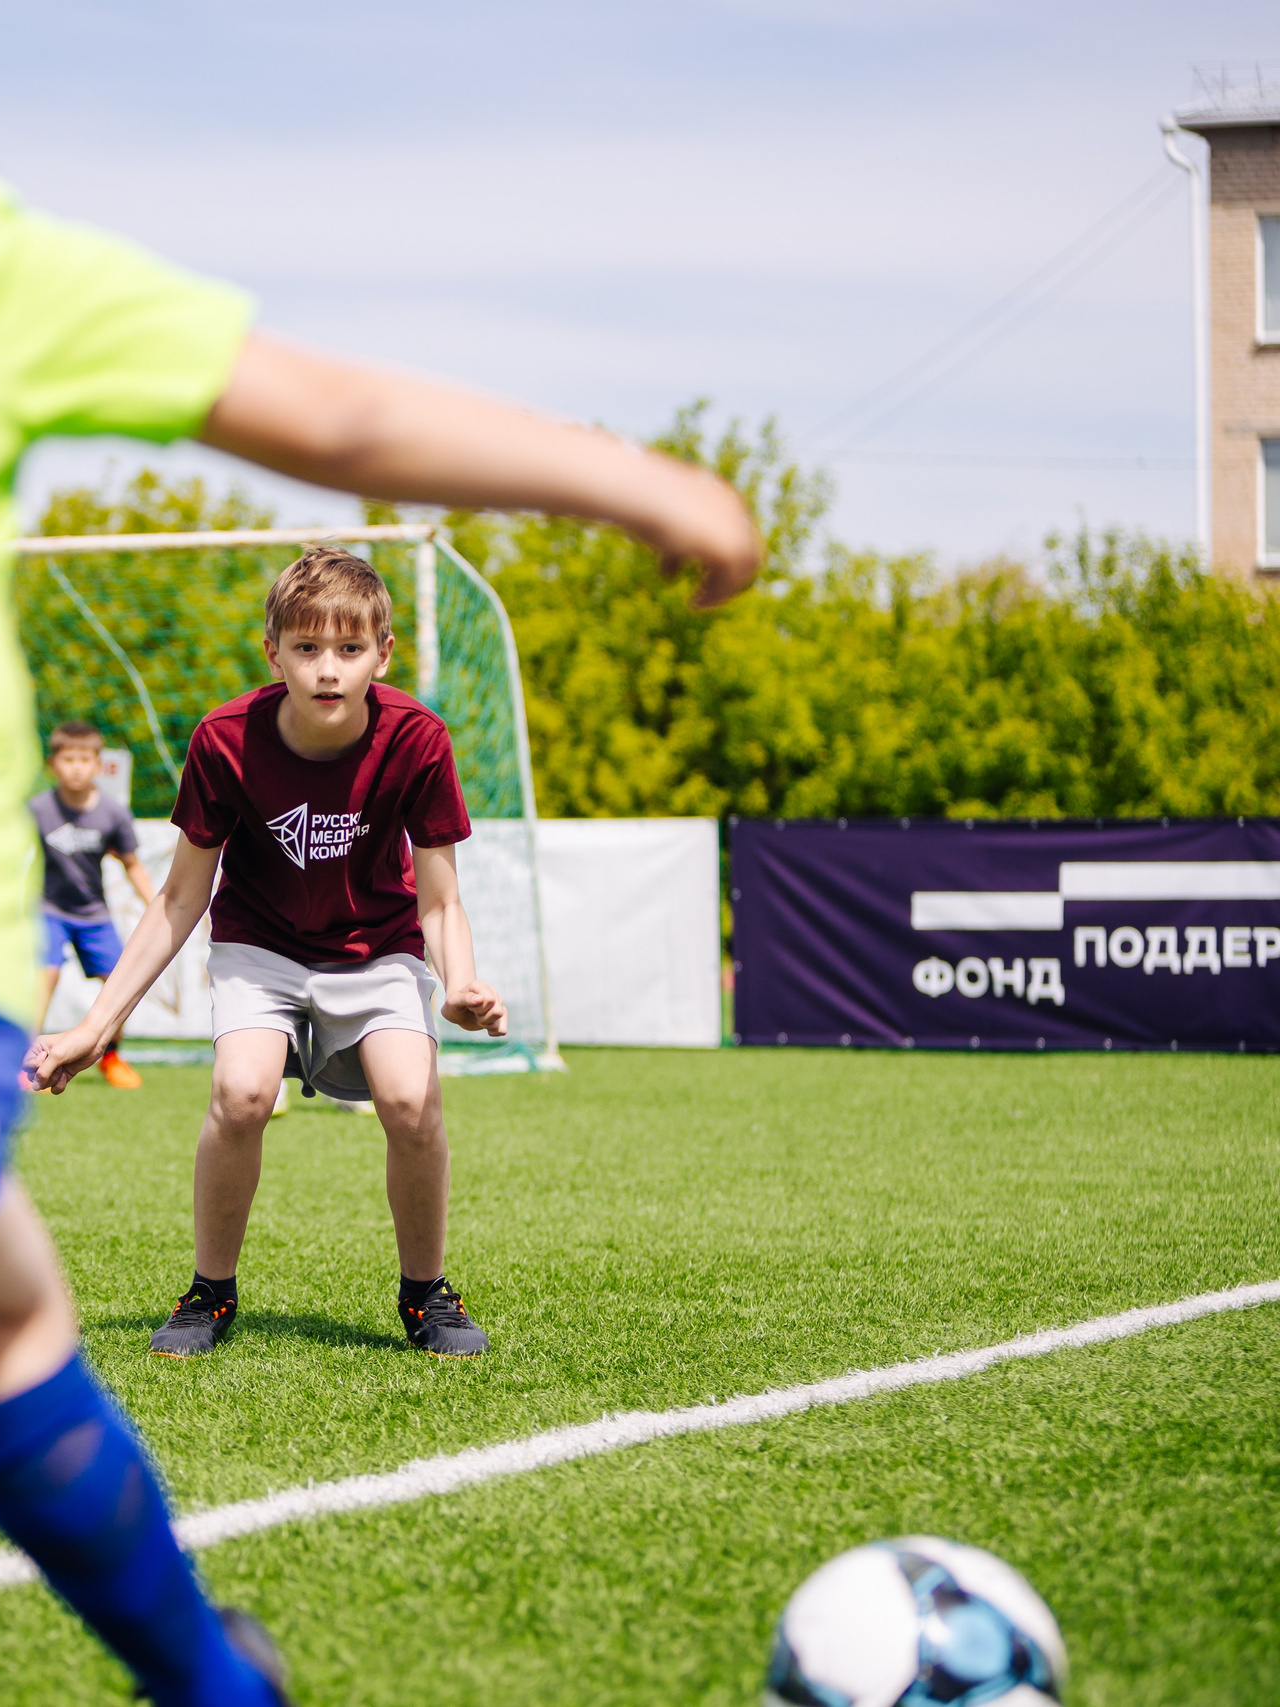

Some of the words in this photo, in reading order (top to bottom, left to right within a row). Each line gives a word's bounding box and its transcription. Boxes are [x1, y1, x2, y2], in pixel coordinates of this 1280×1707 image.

[311, 810, 362, 828] РУССК
[912, 956, 1065, 1005] ФОНД
[1073, 926, 1280, 975] ПОДДЕР
